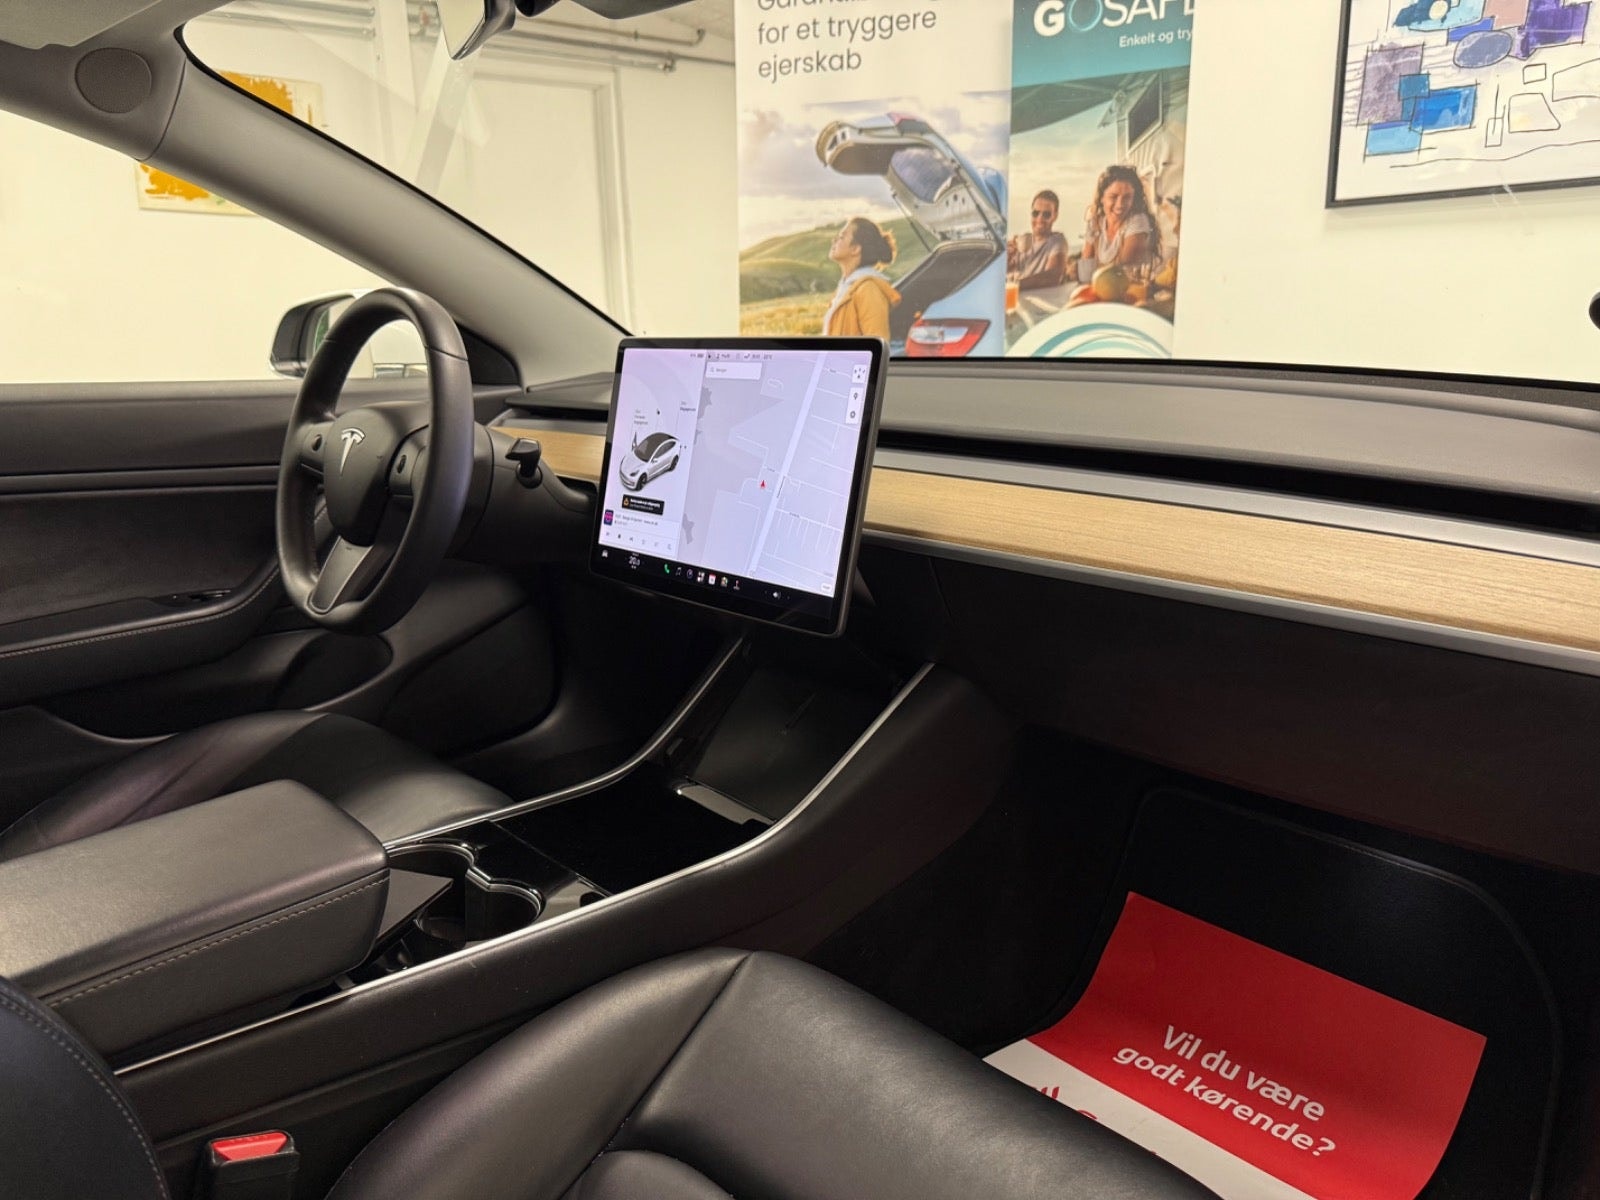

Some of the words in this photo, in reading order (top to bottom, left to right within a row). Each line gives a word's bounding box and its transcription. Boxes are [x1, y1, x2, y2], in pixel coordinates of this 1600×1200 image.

[758, 22, 790, 45] for
[796, 18, 820, 40] et
[828, 10, 937, 43] tryggere
[1119, 31, 1155, 48] Enkelt
[1158, 31, 1174, 44] og
[758, 48, 862, 84] ejerskab
[1163, 1025, 1201, 1060] Vil
[1201, 1050, 1241, 1081] du
[1247, 1072, 1326, 1122] være
[1113, 1047, 1186, 1086] godt
[1183, 1074, 1337, 1158] kørende?
